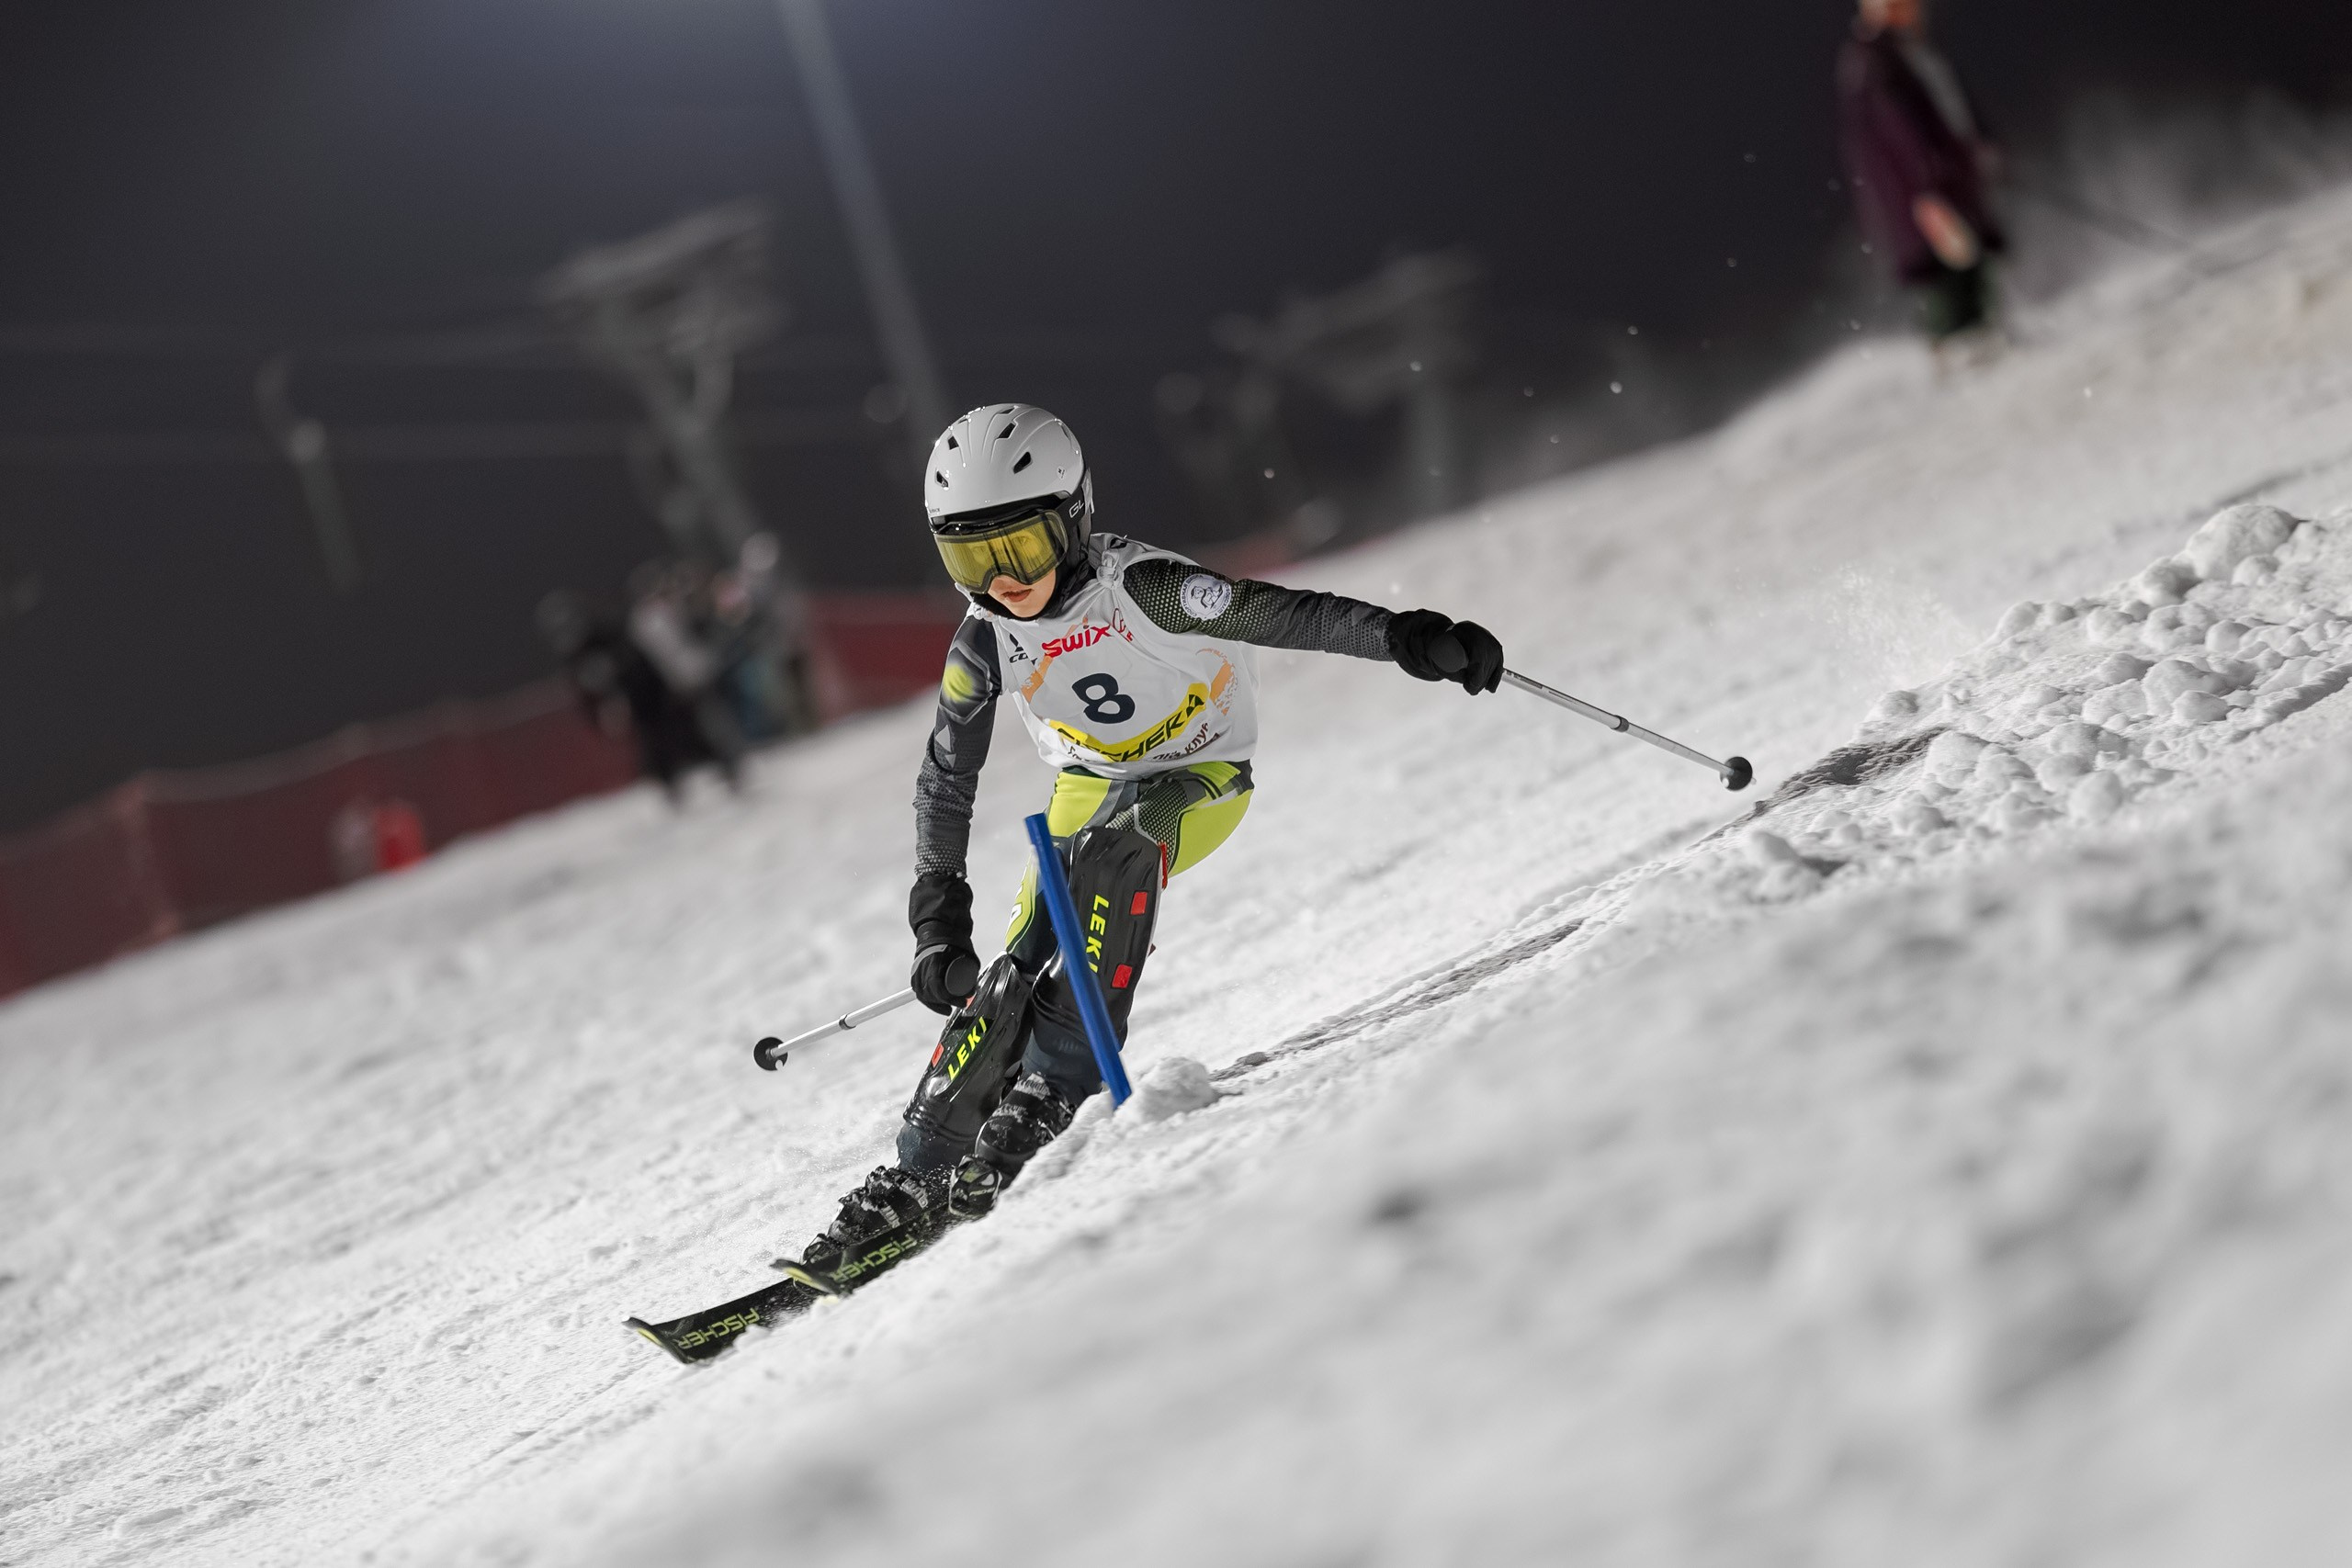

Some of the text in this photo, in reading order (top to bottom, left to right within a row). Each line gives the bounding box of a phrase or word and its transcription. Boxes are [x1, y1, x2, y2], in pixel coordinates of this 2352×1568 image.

[1071, 672, 1136, 724] 8
[1086, 894, 1109, 974] LEKI
[947, 1017, 987, 1081] LEKI
[831, 1234, 917, 1283] FISCHER
[677, 1307, 760, 1350] FISCHER
